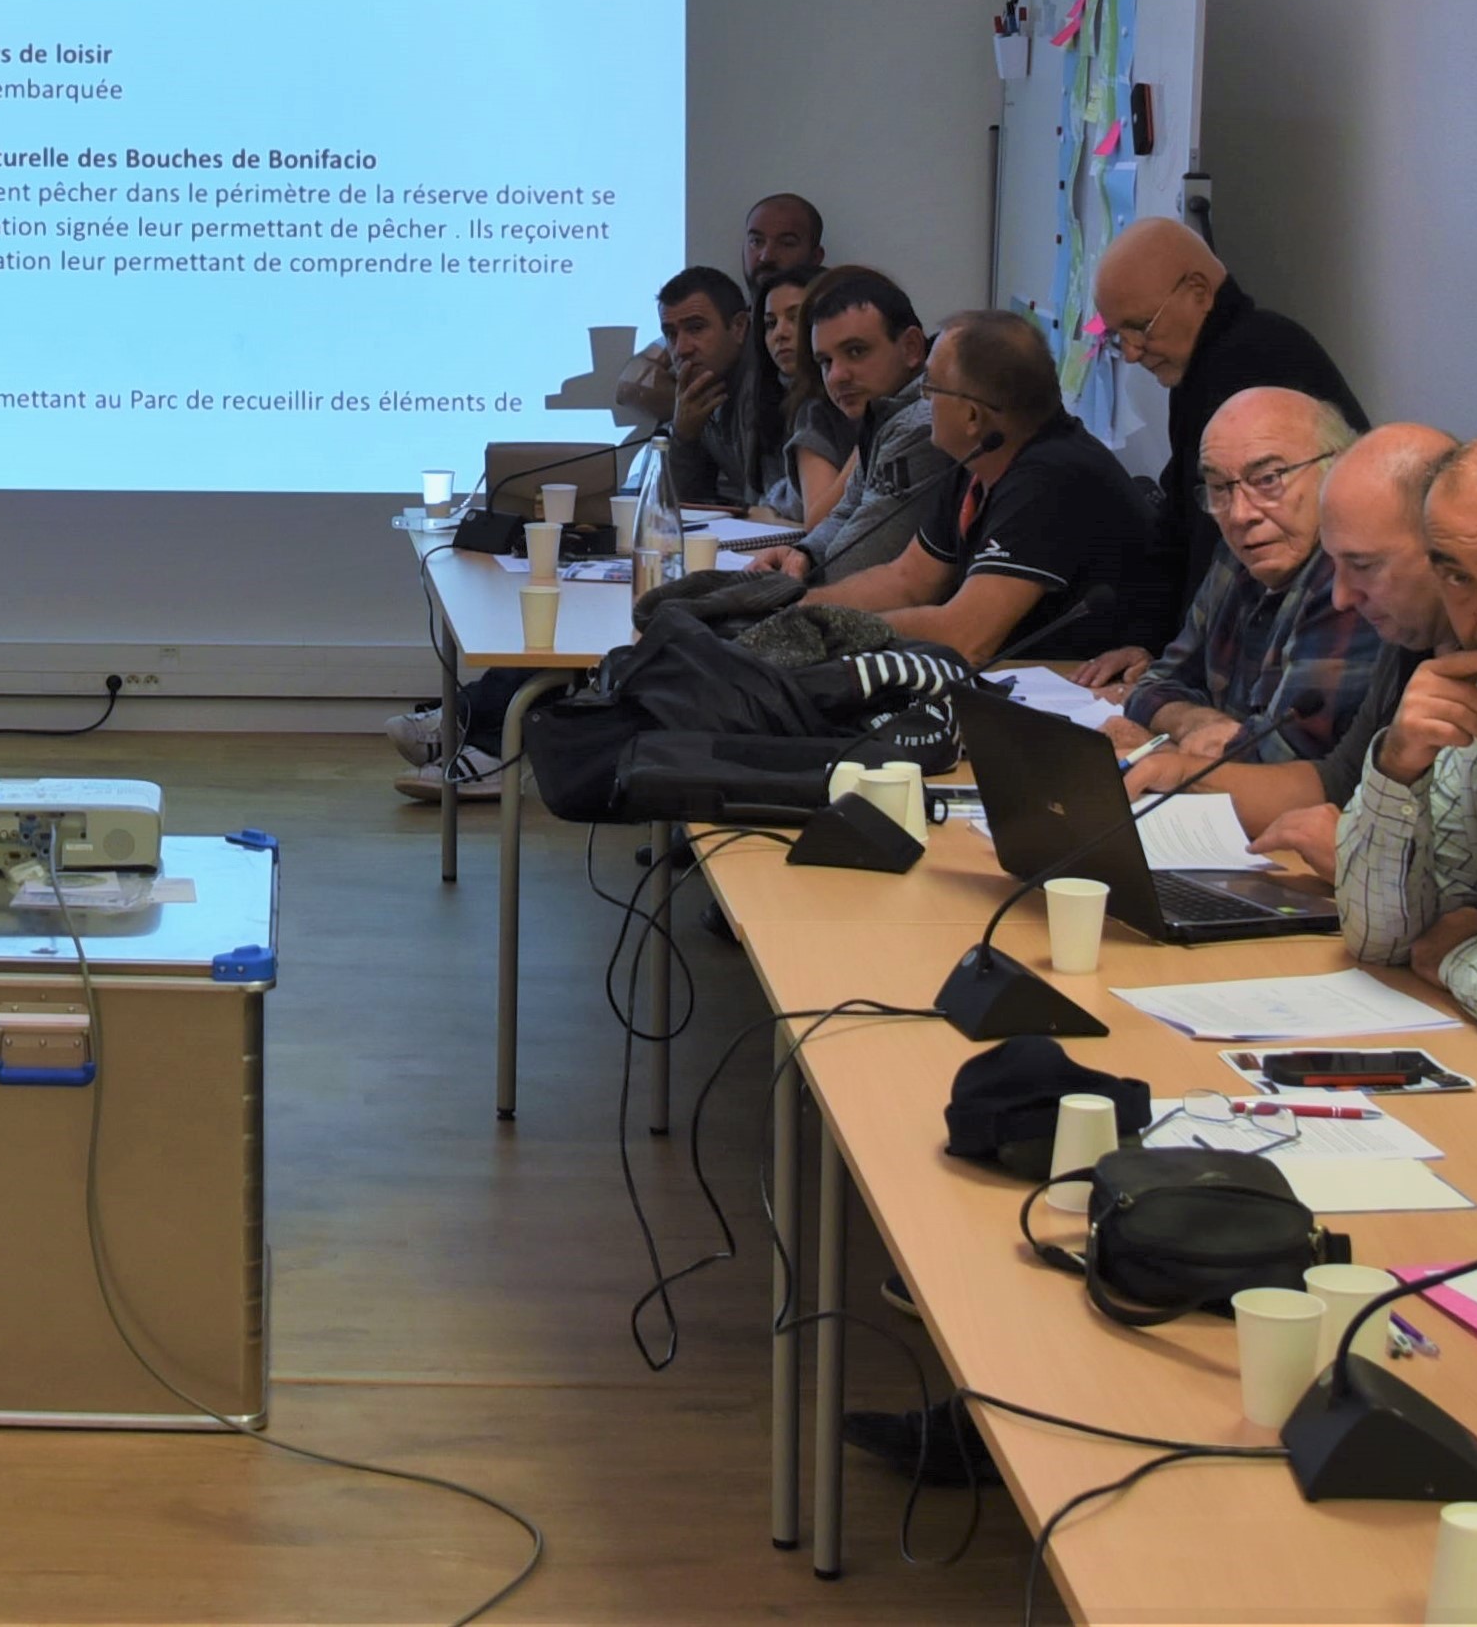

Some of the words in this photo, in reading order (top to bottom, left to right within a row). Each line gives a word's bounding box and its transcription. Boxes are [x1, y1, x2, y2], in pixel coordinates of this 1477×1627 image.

[19, 43, 48, 64] de
[56, 43, 113, 64] loisir
[77, 147, 117, 168] des
[126, 148, 223, 169] Bouches
[232, 148, 260, 169] de
[269, 148, 377, 170] Bonifacio
[38, 181, 118, 207] pêcher
[126, 182, 180, 203] dans
[188, 182, 208, 203] le
[215, 182, 331, 208] périmètre
[338, 183, 367, 204] de
[376, 183, 394, 204] la
[403, 183, 488, 205] réserve
[496, 184, 584, 205] doivent
[592, 190, 615, 205] se
[56, 216, 129, 242] signée
[138, 216, 184, 237] leur
[191, 219, 323, 242] permettant
[330, 217, 358, 238] de
[367, 217, 447, 243] pêcher
[470, 218, 493, 239] Ils
[501, 220, 609, 244] reçoivent
[61, 250, 106, 271] leur
[114, 253, 245, 276] permettant
[253, 251, 282, 273] de
[289, 253, 433, 278] comprendre
[441, 252, 460, 274] le
[468, 254, 573, 274] territoire
[95, 393, 121, 409] au
[131, 389, 178, 410] Parc
[186, 389, 214, 410] de
[222, 390, 324, 411] recueillir
[330, 390, 370, 412] des
[379, 390, 486, 412] éléments
[494, 391, 522, 413] de
